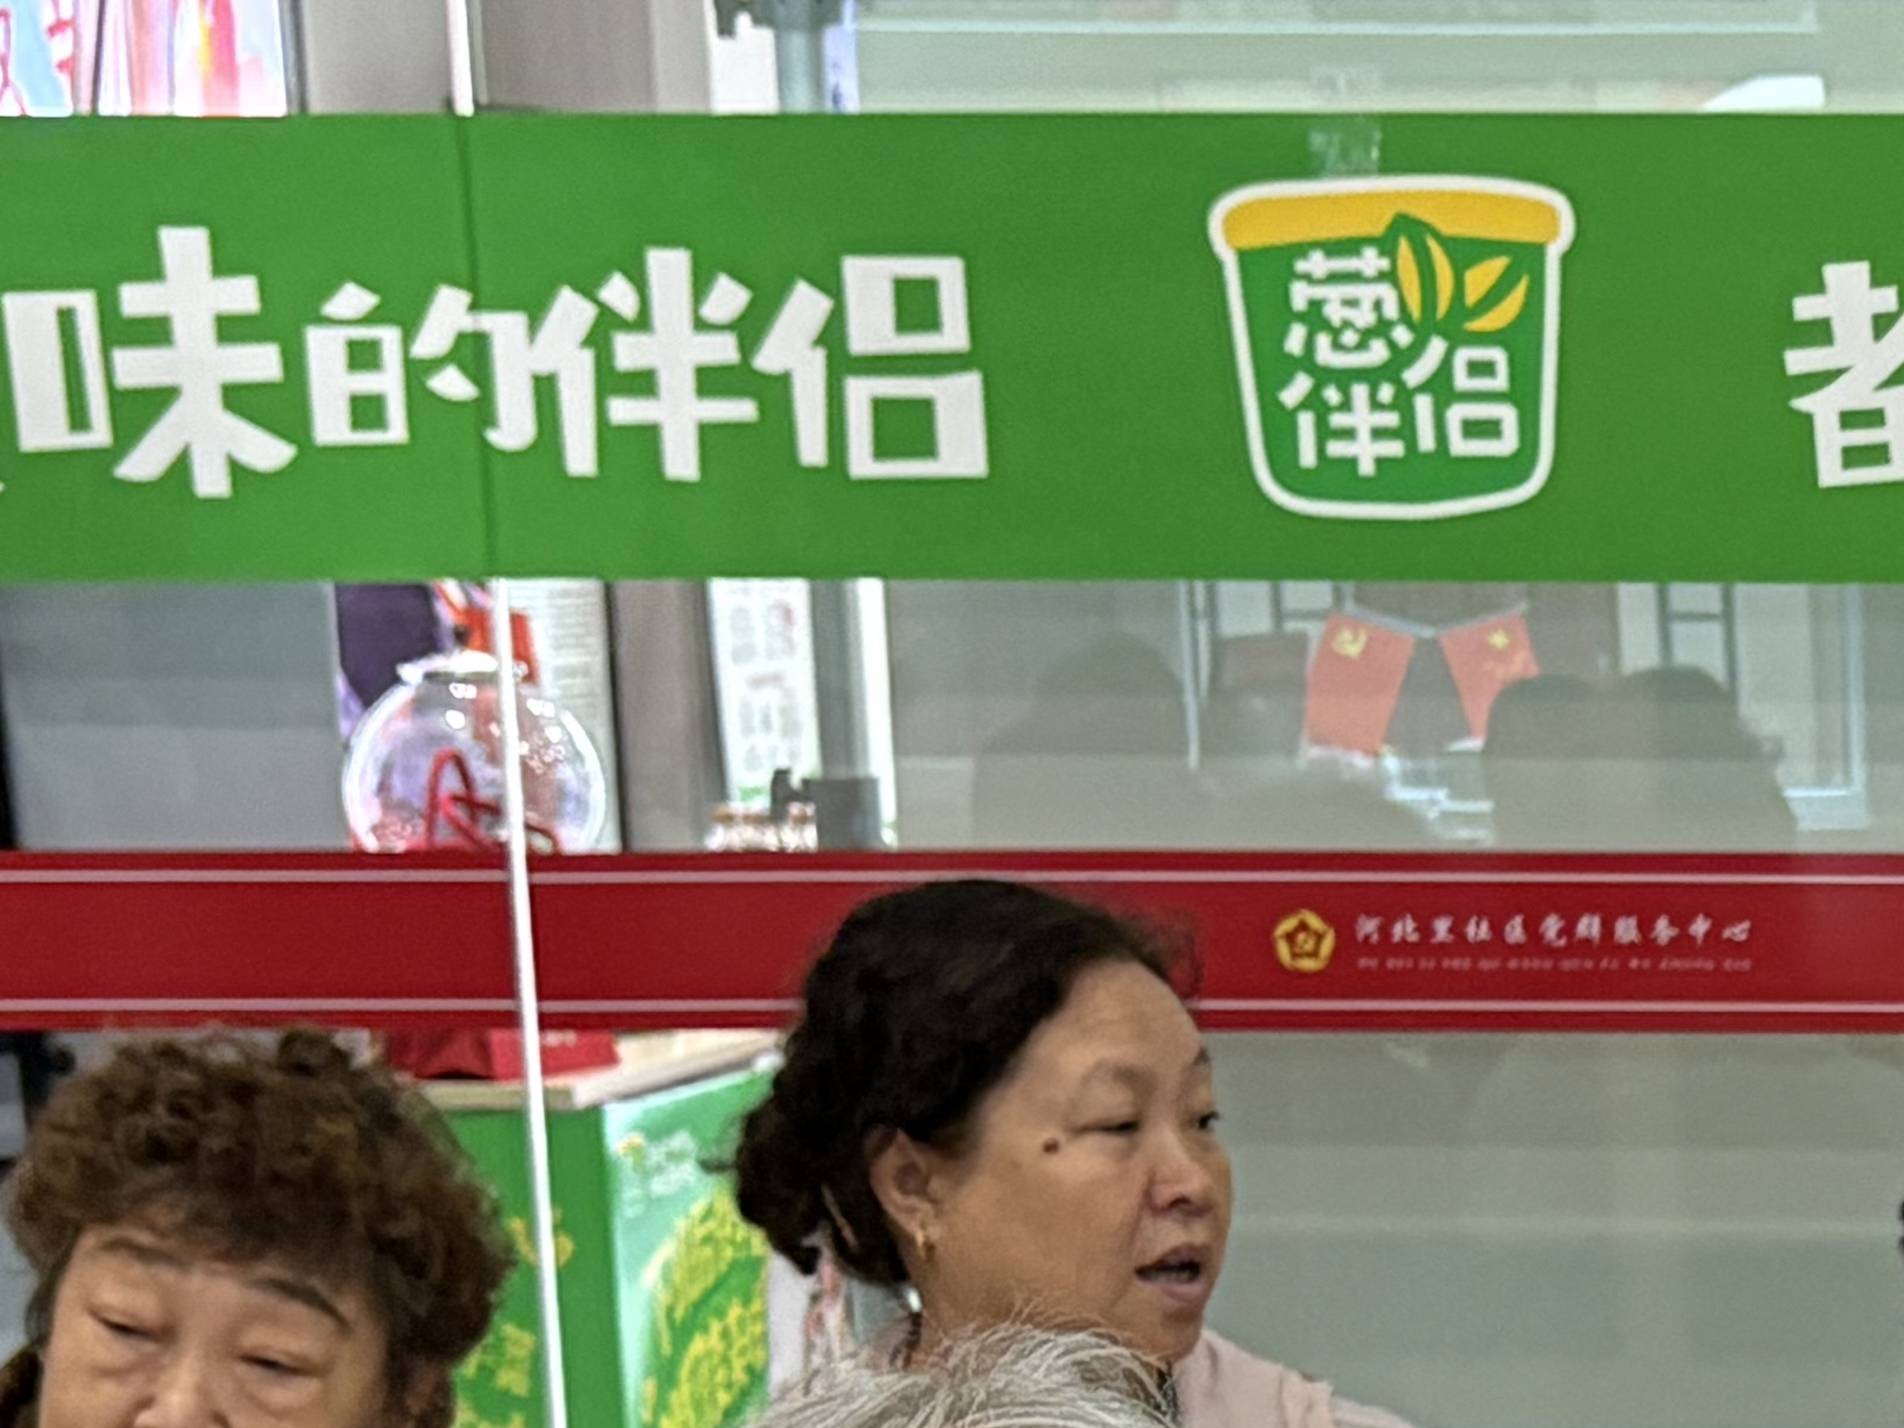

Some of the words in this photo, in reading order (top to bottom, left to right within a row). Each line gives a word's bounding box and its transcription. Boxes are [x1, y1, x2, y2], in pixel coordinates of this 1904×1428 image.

[0, 225, 991, 498] 味的伴侣
[1283, 246, 1414, 368] 葱
[1277, 333, 1520, 477] 伴侣
